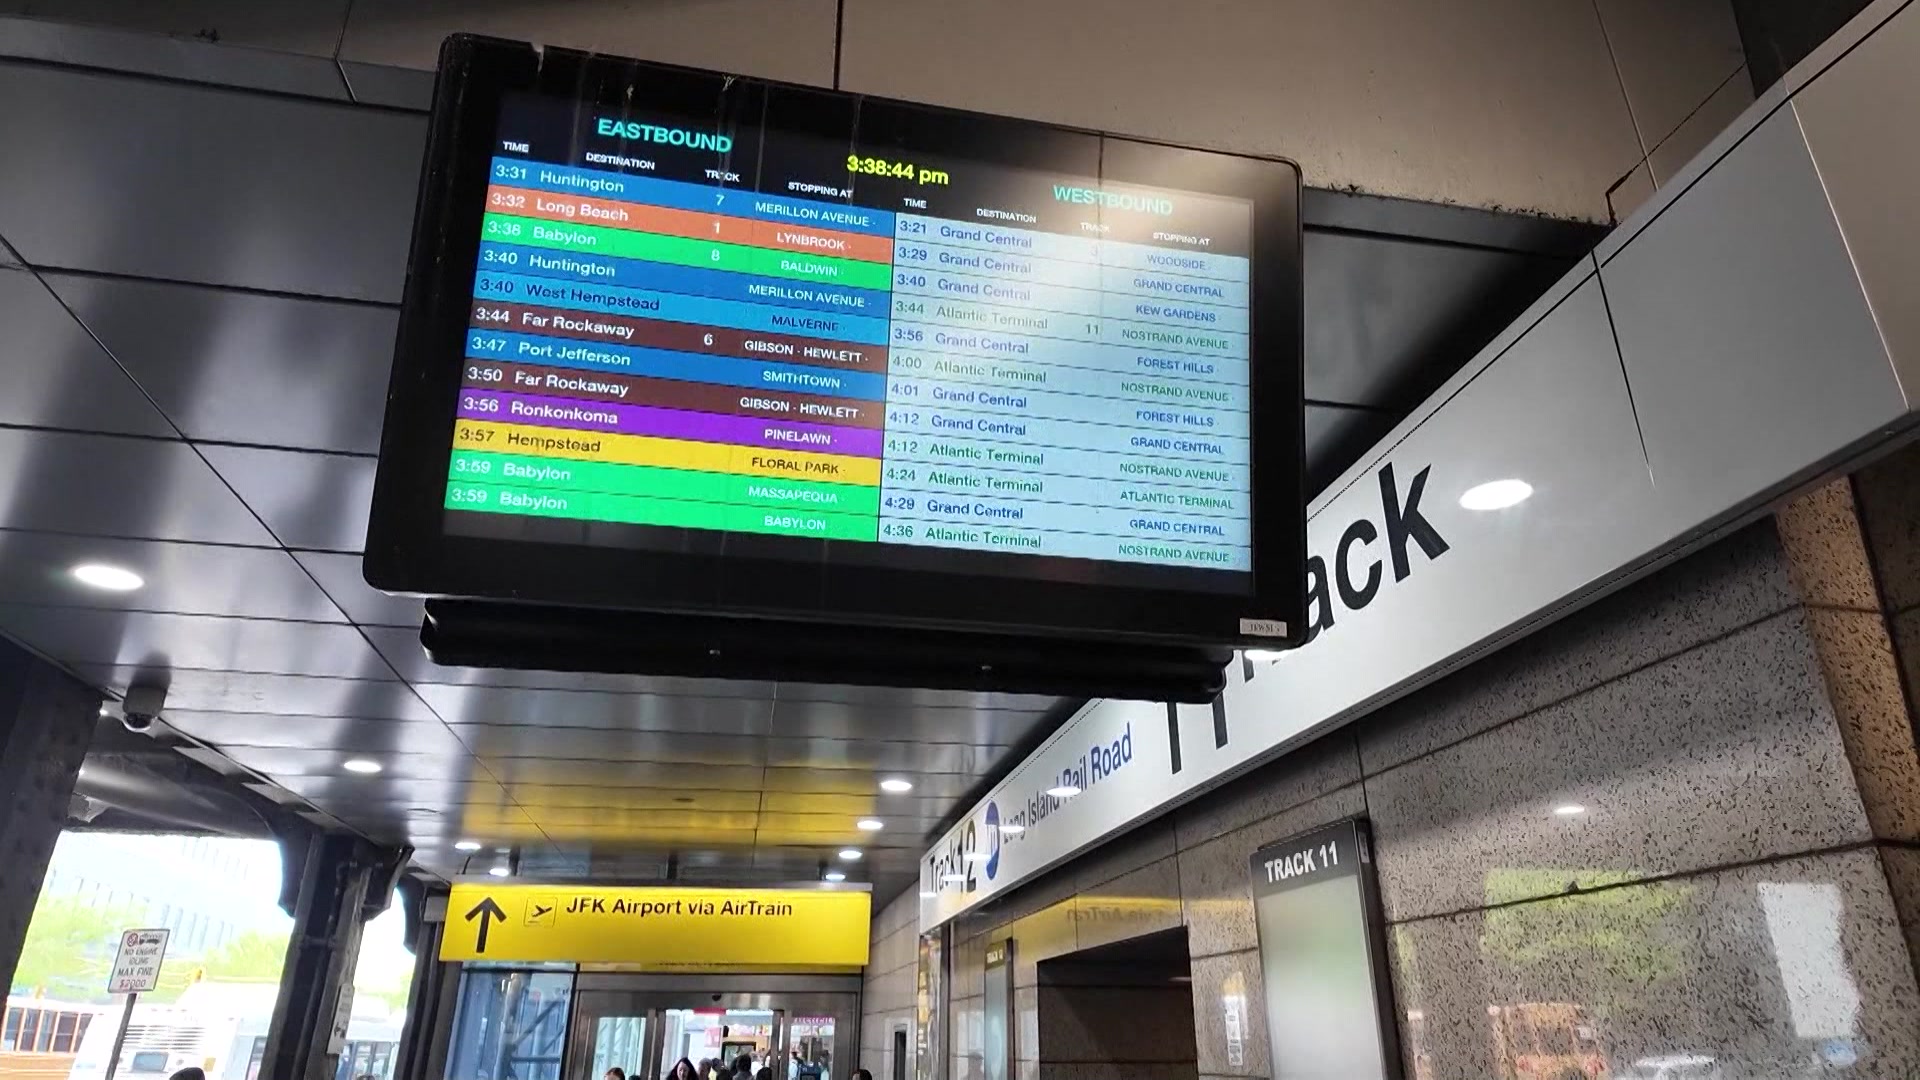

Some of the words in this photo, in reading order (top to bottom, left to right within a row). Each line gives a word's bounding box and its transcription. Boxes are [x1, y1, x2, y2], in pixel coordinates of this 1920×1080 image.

[598, 117, 732, 152] EASTBOUND
[503, 141, 530, 153] TIME
[586, 152, 656, 170] DESTINATION
[788, 181, 838, 198] STOPPING
[840, 189, 853, 199] AT
[847, 154, 914, 180] 3:38:44
[919, 168, 949, 185] pm
[496, 164, 527, 180] 3:31
[540, 170, 624, 193] Huntington
[716, 194, 724, 206] 7
[755, 201, 818, 220] MERILLON
[820, 211, 870, 227] AVENUE
[1053, 184, 1173, 216] WESTBOUND
[491, 192, 525, 208] 3:32
[536, 198, 575, 216] Long
[580, 204, 629, 222] Beach
[713, 222, 720, 234] 1
[776, 232, 845, 250] LYNBROOK
[900, 220, 927, 234] 3:21
[940, 225, 980, 242] Grand
[984, 231, 1032, 249] Central
[1146, 254, 1206, 270] WOODSIDE
[904, 197, 927, 209] TIME
[976, 208, 1036, 224] DESTINATION
[1153, 231, 1196, 245] STOPPING
[1198, 236, 1210, 246] AT
[488, 220, 521, 236] 3:38
[533, 226, 597, 246] Babylon
[711, 250, 720, 262] 8
[780, 260, 838, 276] BALDWIN
[898, 246, 928, 261] 3:29
[938, 252, 980, 268] Grand
[984, 258, 1032, 274] Central
[1134, 278, 1172, 292] GRAND
[1175, 284, 1224, 298] CENTRAL
[484, 250, 518, 266] 3:40
[530, 254, 616, 277] Huntington
[748, 284, 812, 301] MERILLON
[816, 292, 865, 308] AVENUE
[897, 274, 926, 288] 3:40
[938, 278, 979, 295] Grand
[982, 284, 1031, 300] Central
[1136, 304, 1161, 316] KEW
[1164, 309, 1216, 322] GARDENS
[480, 278, 514, 294] 3:40
[526, 284, 566, 299] West
[571, 288, 660, 311] Hempstead
[771, 315, 839, 332] MALVERNE
[896, 300, 924, 315] 3:44
[936, 306, 987, 322] Atlantic
[992, 312, 1048, 330] Terminal
[1086, 324, 1099, 335] 11
[1122, 330, 1183, 344] NOSTRAND
[1186, 336, 1228, 350] AVENUE
[476, 306, 510, 323] 3:44
[522, 312, 550, 326] Far
[553, 316, 635, 340] Rockaway
[704, 333, 713, 346] 6
[744, 340, 794, 356] GIBSON
[804, 346, 862, 362] HEWLETT
[894, 328, 924, 342] 3:56
[935, 332, 976, 348] Grand
[980, 338, 1029, 354] Central
[1137, 356, 1180, 370] FOREST
[1183, 362, 1214, 374] HILLS
[472, 336, 507, 352] 3:47
[518, 342, 552, 356] Port
[556, 347, 631, 366] Jefferson
[762, 370, 840, 388] SMITHTOWN
[892, 356, 922, 370] 4:00
[934, 360, 985, 376] Atlantic
[991, 368, 1047, 383] Terminal
[1121, 382, 1182, 396] NOSTRAND
[1186, 388, 1229, 402] AVENUE
[468, 366, 503, 382] 3:50
[514, 371, 542, 386] Far
[546, 374, 629, 398] Rockaway
[740, 396, 790, 412] GIBSON
[800, 402, 858, 419] HEWLETT
[891, 384, 919, 396] 4:01
[932, 386, 975, 402] Grand
[978, 392, 1027, 408] Central
[1136, 410, 1180, 424] FOREST
[1182, 415, 1214, 426] HILLS
[464, 396, 499, 412] 3:56
[511, 400, 618, 424] Ronkonkoma
[764, 428, 830, 445] PINELAWN
[890, 412, 920, 426] 4:12
[932, 414, 973, 430] Grand
[978, 420, 1026, 436] Central
[1130, 436, 1170, 450] GRAND
[1174, 440, 1224, 455] CENTRAL
[460, 426, 495, 442] 3:57
[508, 432, 601, 453] Hempstead
[752, 456, 800, 472] FLORAL
[804, 462, 838, 474] PARK
[888, 439, 918, 454] 4:12
[929, 443, 982, 460] Atlantic
[986, 448, 1044, 466] Terminal
[1120, 463, 1182, 478] NOSTRAND
[1184, 469, 1229, 482] AVENUE
[456, 458, 492, 474] 3:59
[504, 462, 571, 482] Babylon
[748, 486, 838, 504] MASSAPEQUA
[886, 468, 916, 482] 4:24
[928, 472, 980, 488] Atlantic
[985, 477, 1043, 493] Terminal
[1120, 490, 1175, 504] ATLANTIC
[1179, 496, 1234, 510] TERMINAL
[451, 487, 488, 502] 3:59
[500, 491, 568, 510] Babylon
[764, 515, 826, 530] BABYLON
[884, 496, 915, 510] 4:29
[927, 500, 970, 515] Grand
[974, 504, 1024, 520] Central
[1130, 520, 1170, 532] GRAND
[1173, 524, 1226, 536] CENTRAL
[883, 525, 914, 538] 4:36
[925, 527, 978, 543] Atlantic
[984, 532, 1041, 548] Terminal
[1118, 544, 1182, 558] NOSTRAND
[1185, 550, 1230, 562] AVENUE
[1028, 776, 1060, 827] Island
[1062, 755, 1088, 803] Rail
[1090, 722, 1133, 785] Road
[930, 838, 956, 893] Track
[958, 820, 976, 894] 12
[1264, 848, 1316, 883] TRACK
[1320, 840, 1338, 868] 11
[566, 896, 606, 914] JFK
[612, 898, 682, 918] Airport
[688, 899, 715, 916] via
[720, 900, 792, 916] AirTrain
